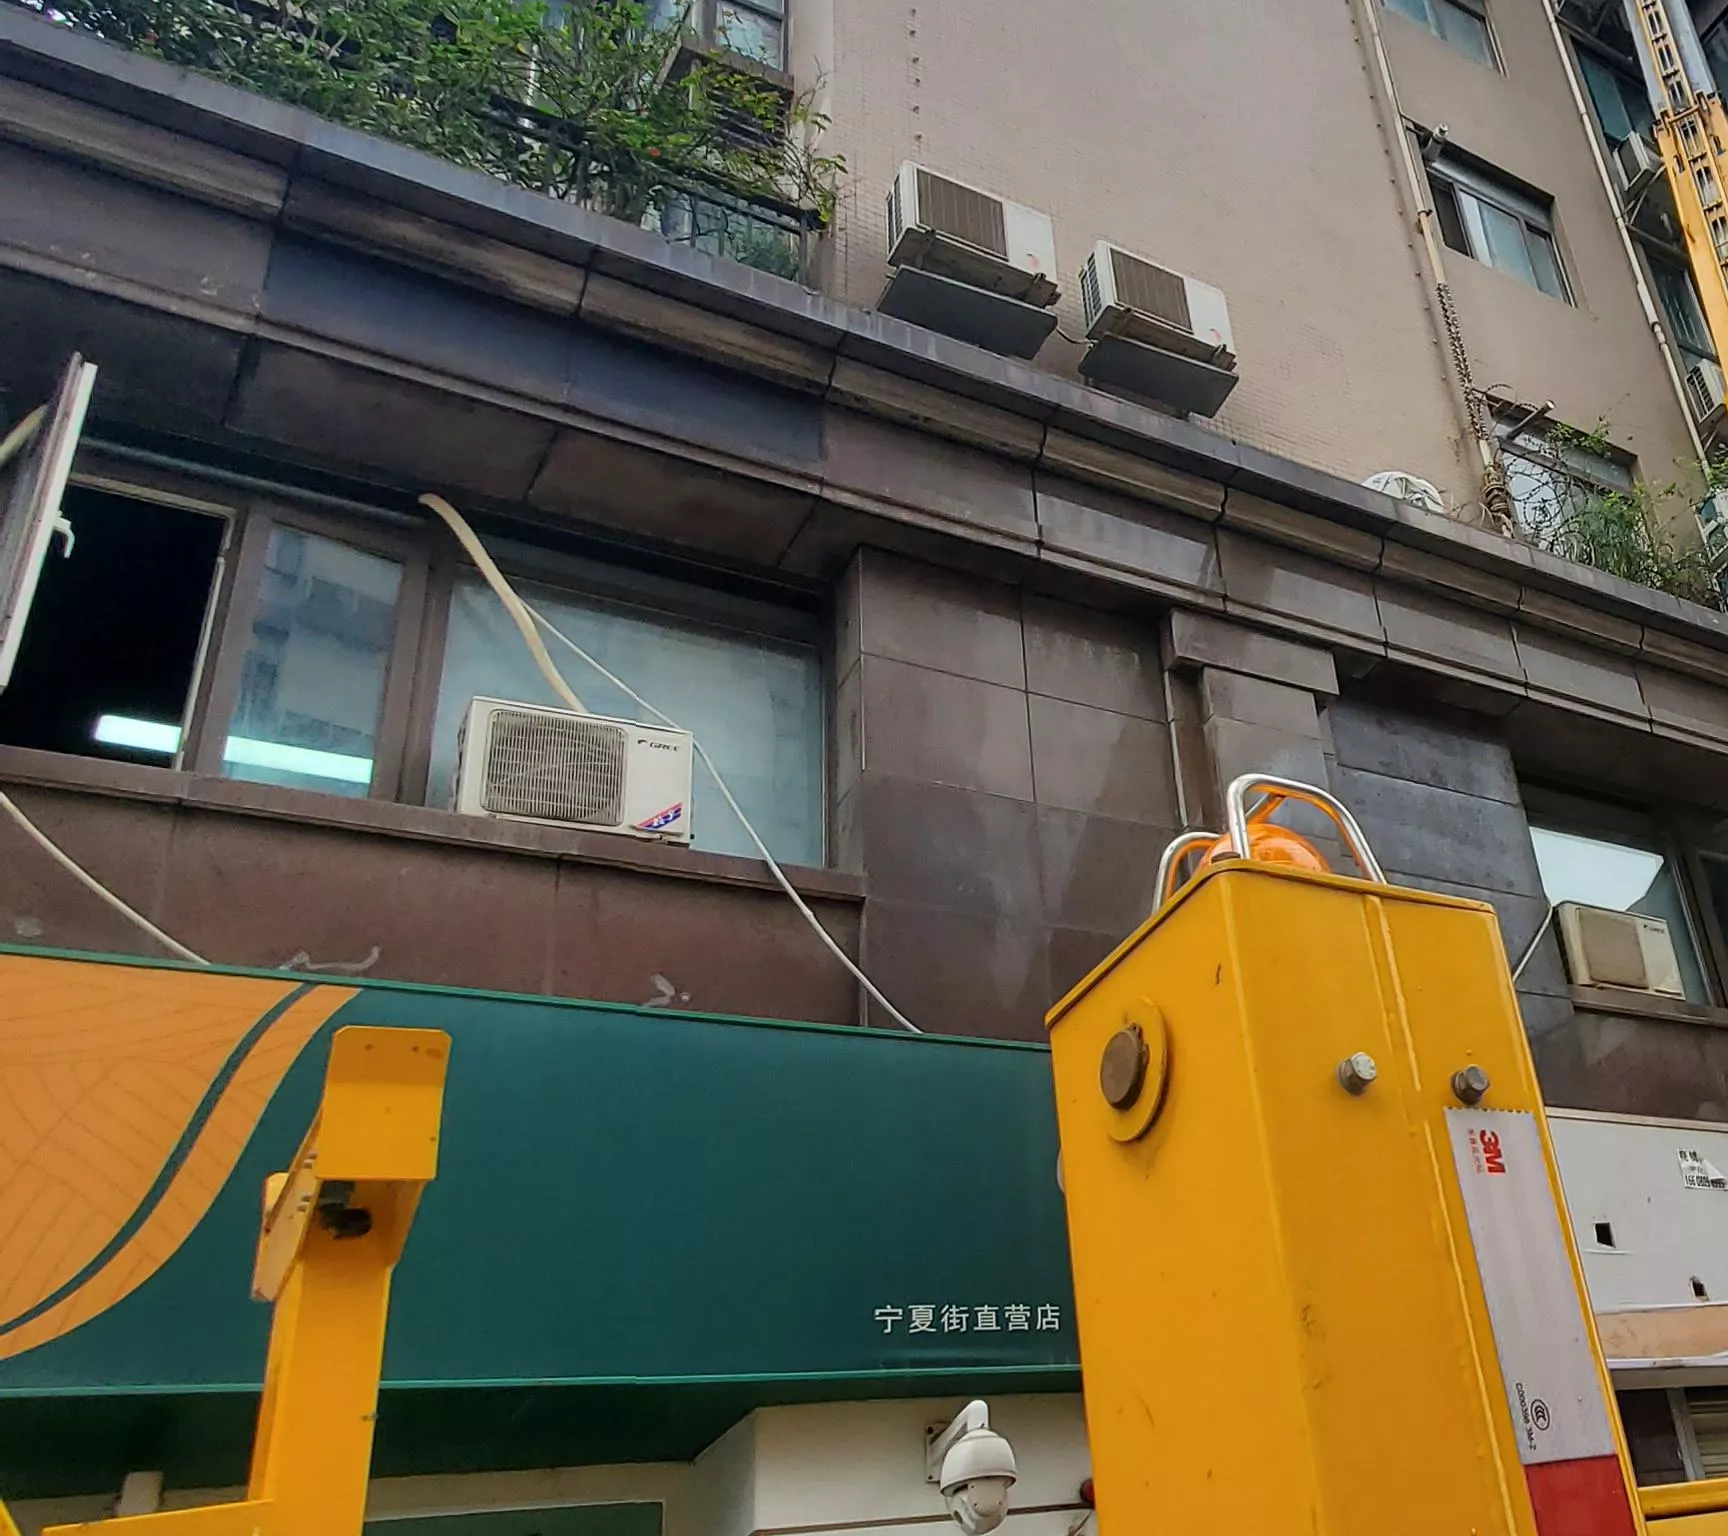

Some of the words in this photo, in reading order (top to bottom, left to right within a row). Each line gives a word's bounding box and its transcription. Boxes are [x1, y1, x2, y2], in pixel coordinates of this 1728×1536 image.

[1479, 1129, 1505, 1174] 3M
[874, 1303, 1061, 1334] 宁夏街直营店
